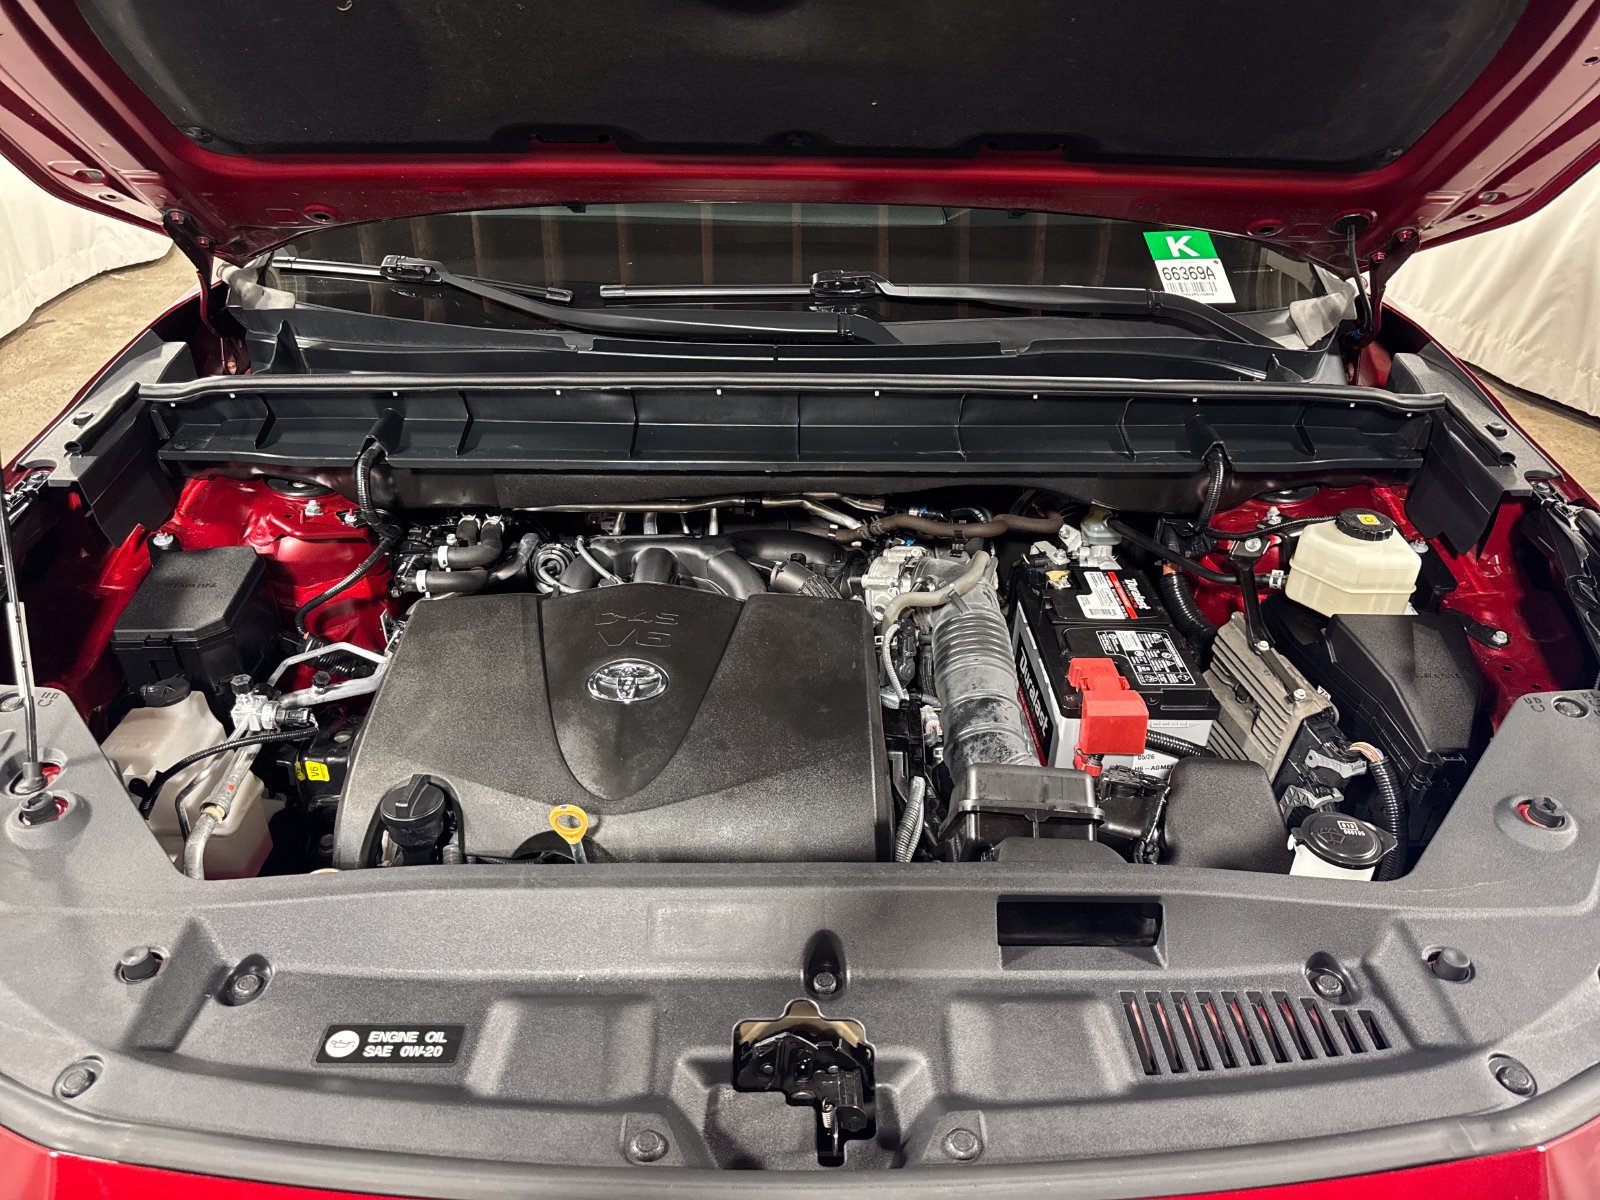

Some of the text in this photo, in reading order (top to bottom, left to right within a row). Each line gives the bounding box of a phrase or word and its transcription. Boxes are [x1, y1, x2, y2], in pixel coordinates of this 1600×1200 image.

[1165, 235, 1200, 257] K
[1162, 266, 1216, 281] 66369A
[1124, 578, 1152, 610] Duralast
[1020, 646, 1049, 738] Duralast
[367, 1031, 448, 1043] ENGINE OIL
[362, 1045, 444, 1058] SAE 0W-20
